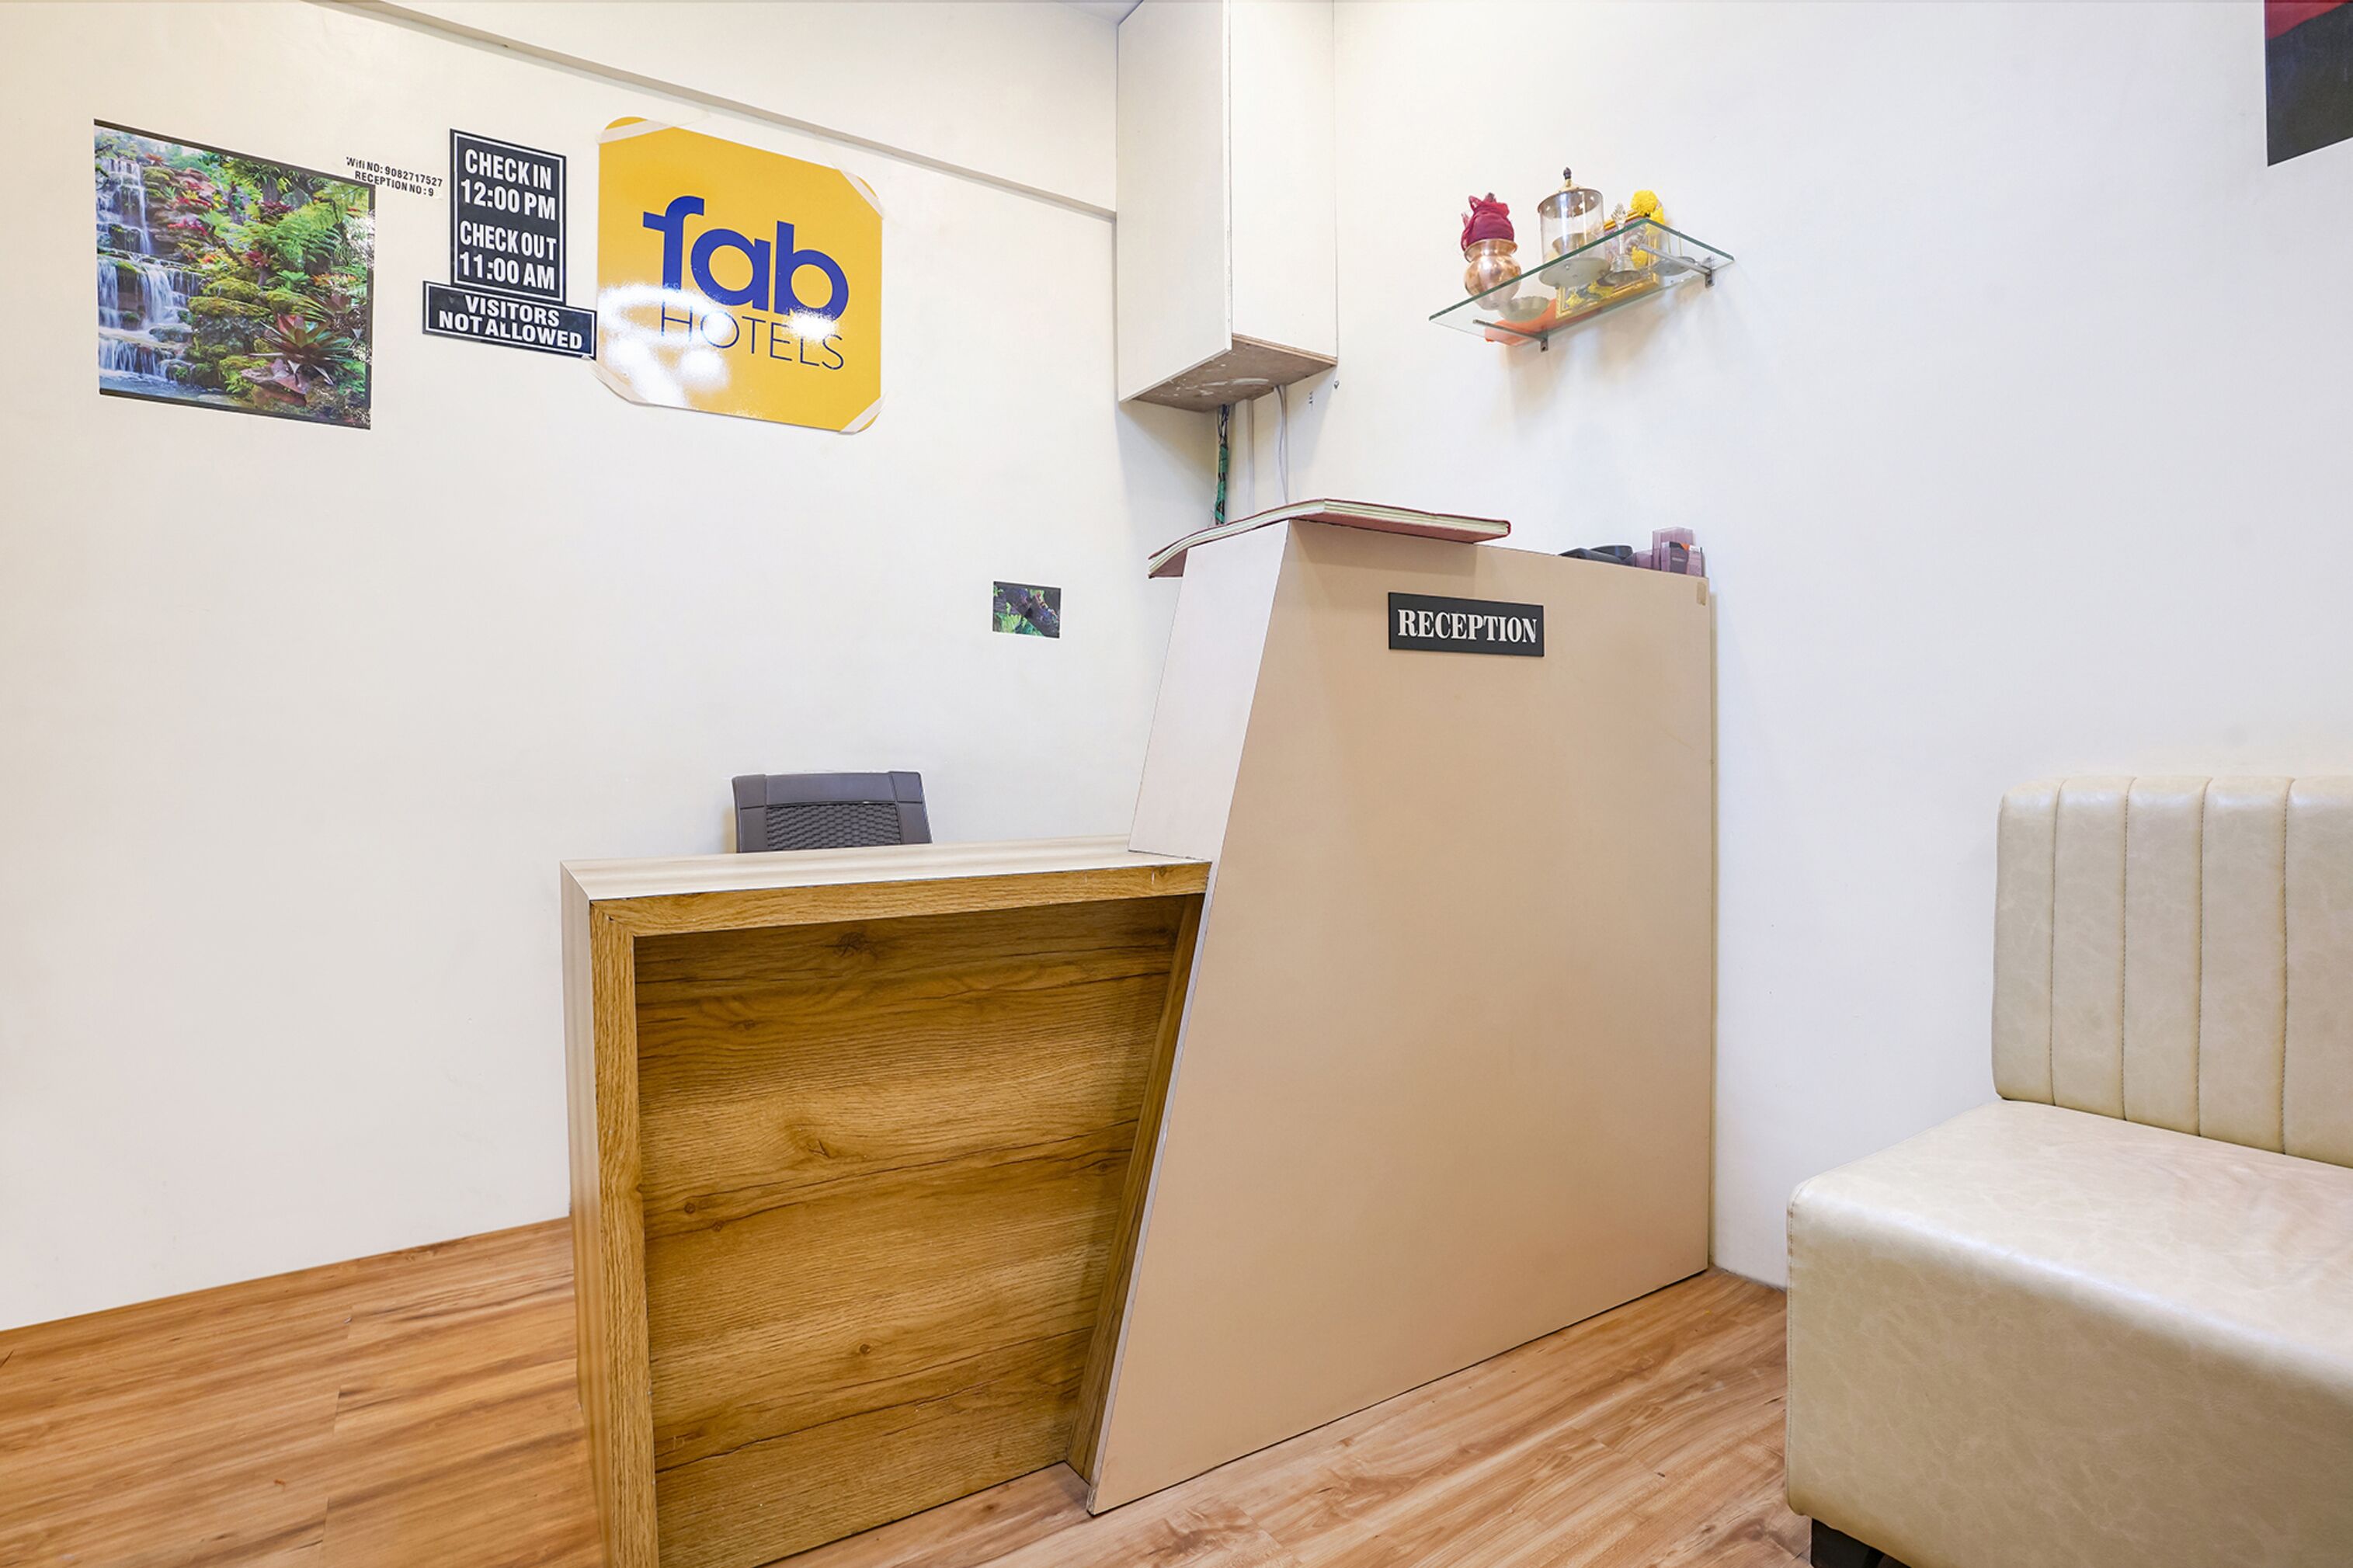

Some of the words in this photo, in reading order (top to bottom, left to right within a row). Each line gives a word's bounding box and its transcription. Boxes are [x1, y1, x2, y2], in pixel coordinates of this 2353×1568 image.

[354, 170, 408, 191] RECEPTION
[384, 165, 443, 187] 9082717527
[465, 148, 530, 186] CHECK
[533, 163, 551, 190] IN
[461, 179, 520, 214] 12:00
[524, 191, 555, 221] PM
[460, 220, 519, 255] CHECK
[521, 231, 557, 261] OUT
[643, 195, 849, 322] fab
[460, 251, 520, 284] 11:00
[523, 262, 554, 290] AM
[440, 310, 482, 333] NOT
[485, 318, 582, 349] ALLOWED
[465, 294, 560, 328] VISITORS
[661, 300, 844, 370] HOTELS
[1397, 608, 1537, 644] RECEPTION
